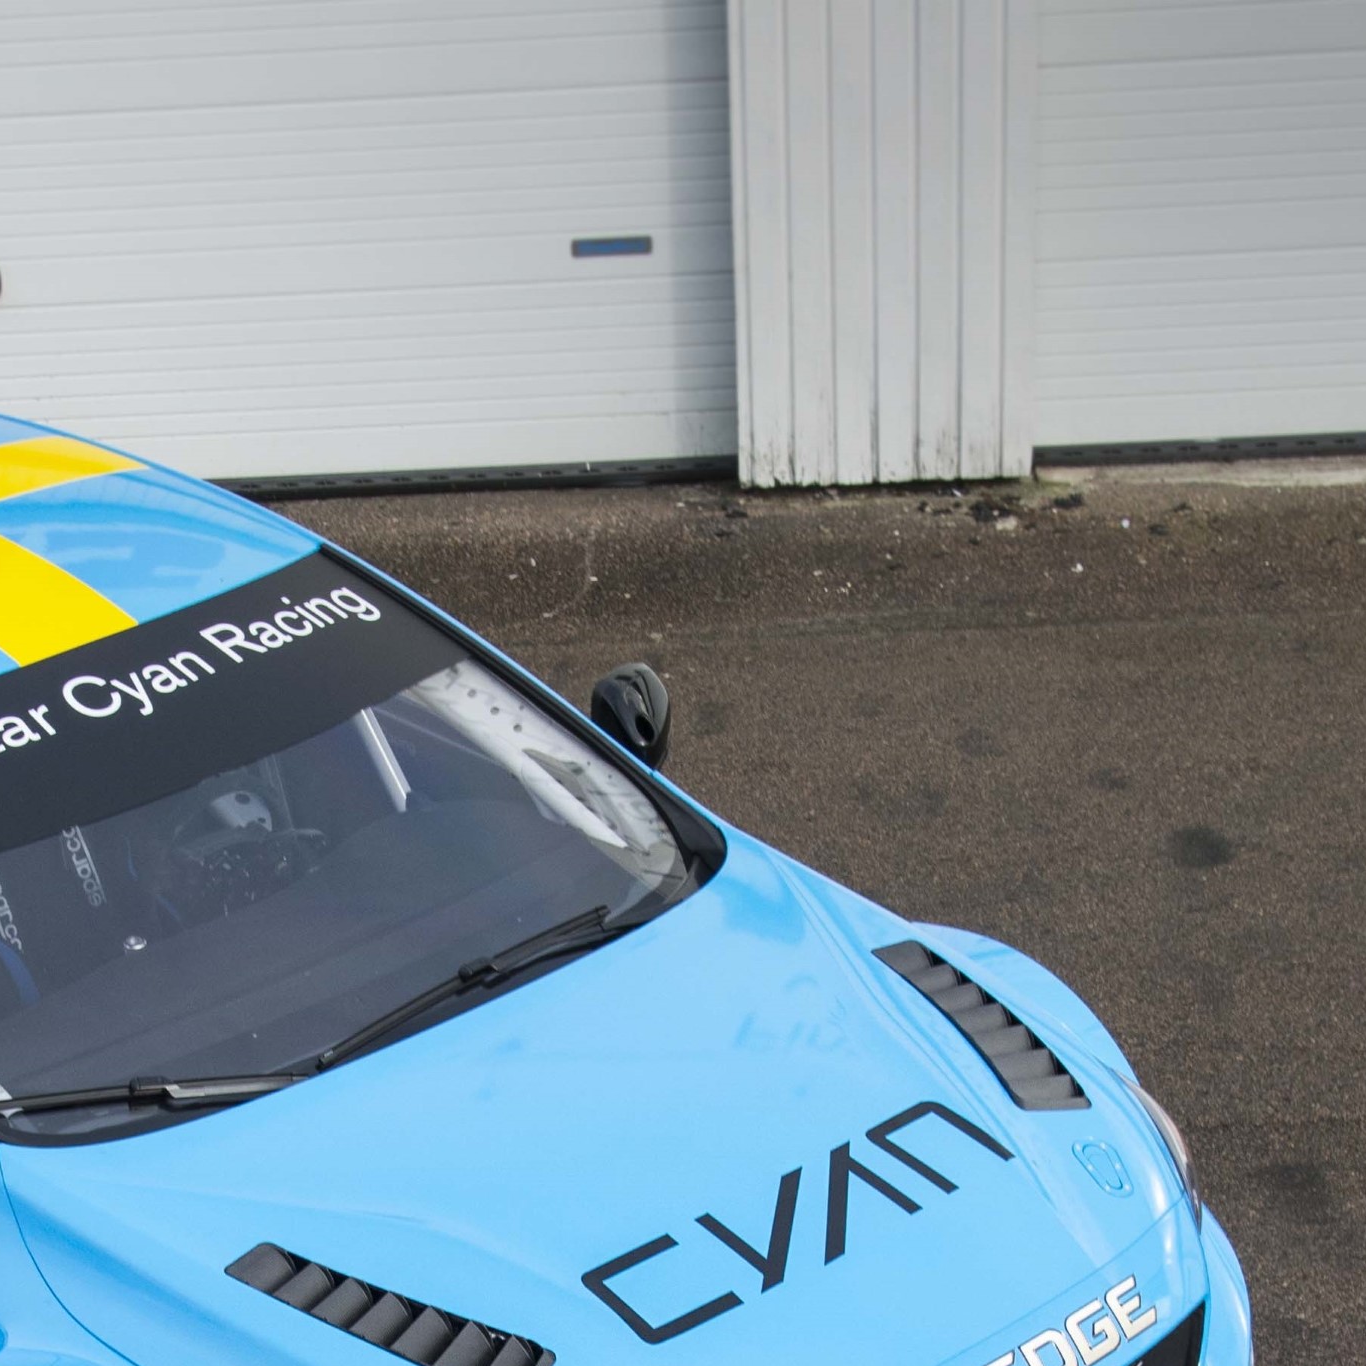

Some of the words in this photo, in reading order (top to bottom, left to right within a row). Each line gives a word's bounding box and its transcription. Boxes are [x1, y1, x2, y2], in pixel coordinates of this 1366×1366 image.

[62, 651, 216, 715] Cyan
[199, 585, 381, 664] Racing
[581, 1101, 1016, 1345] CYAN
